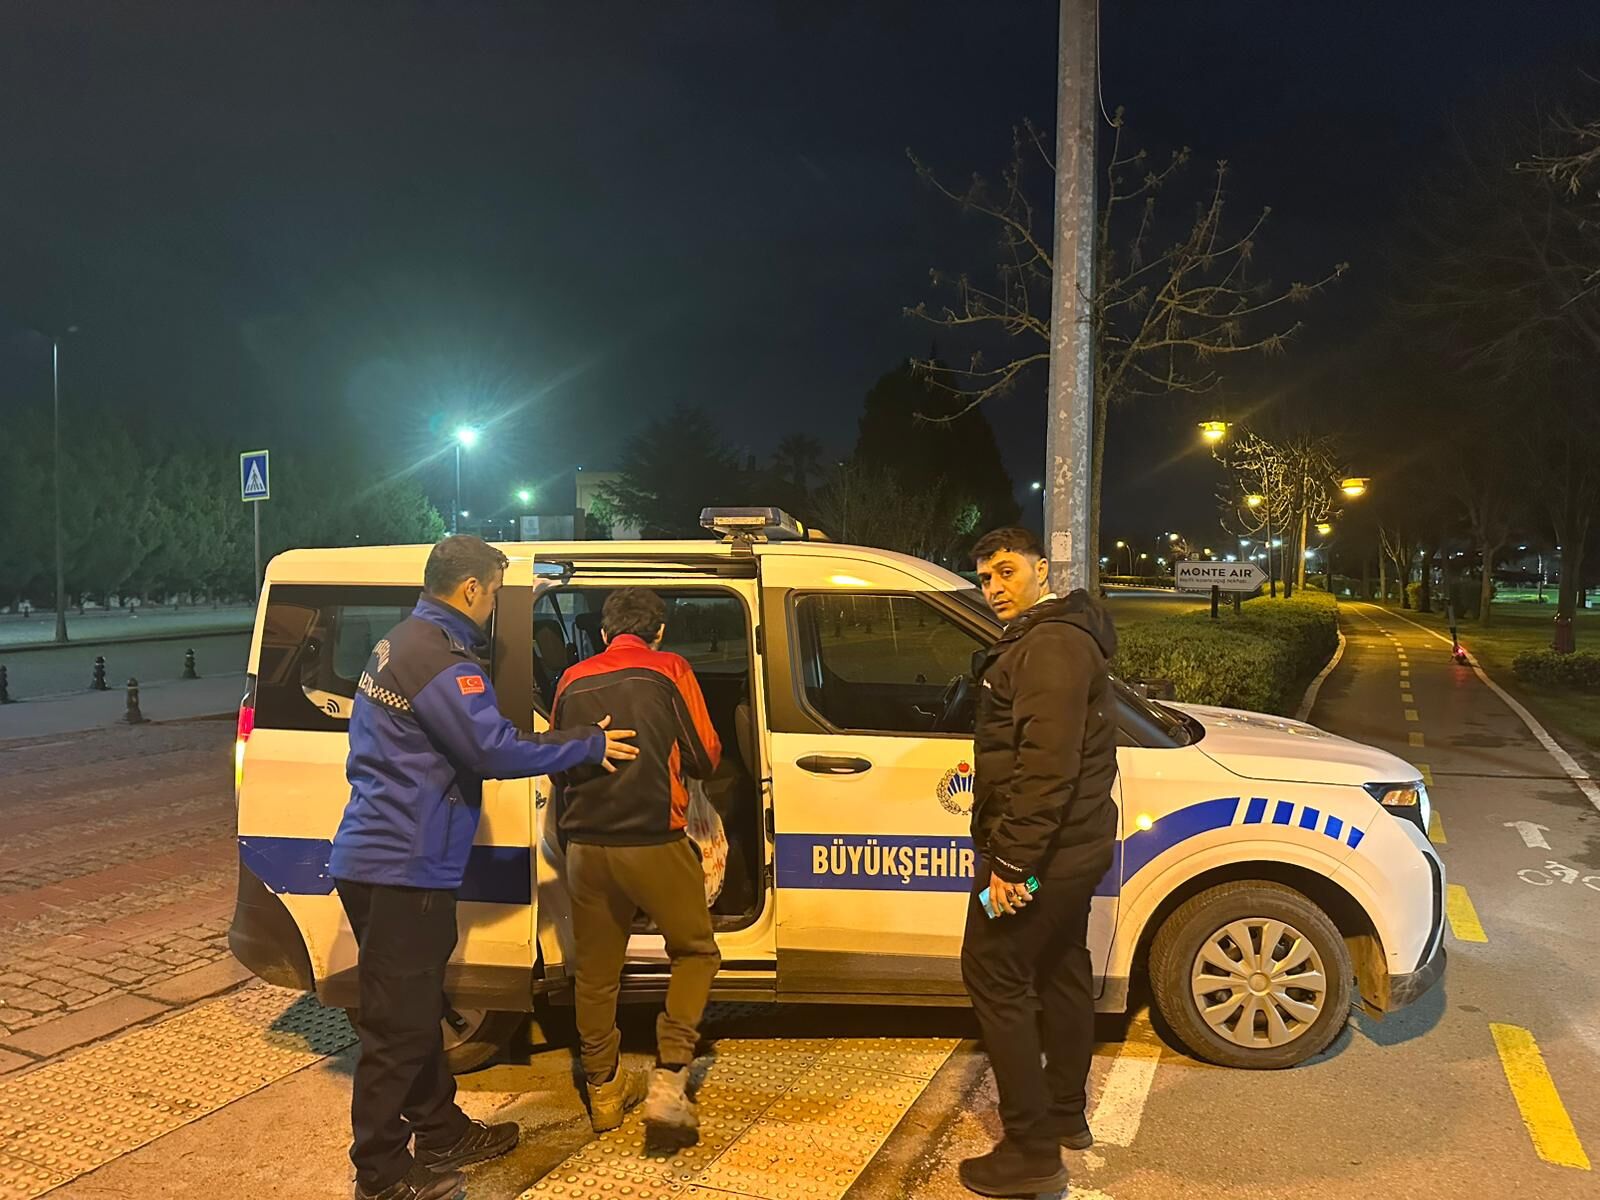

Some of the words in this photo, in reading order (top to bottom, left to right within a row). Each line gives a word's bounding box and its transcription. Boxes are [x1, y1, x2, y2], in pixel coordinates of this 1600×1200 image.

[1180, 568, 1226, 577] MONTE
[1230, 568, 1252, 577] AIR
[812, 838, 976, 884] BÜYÜKŞEHİR
